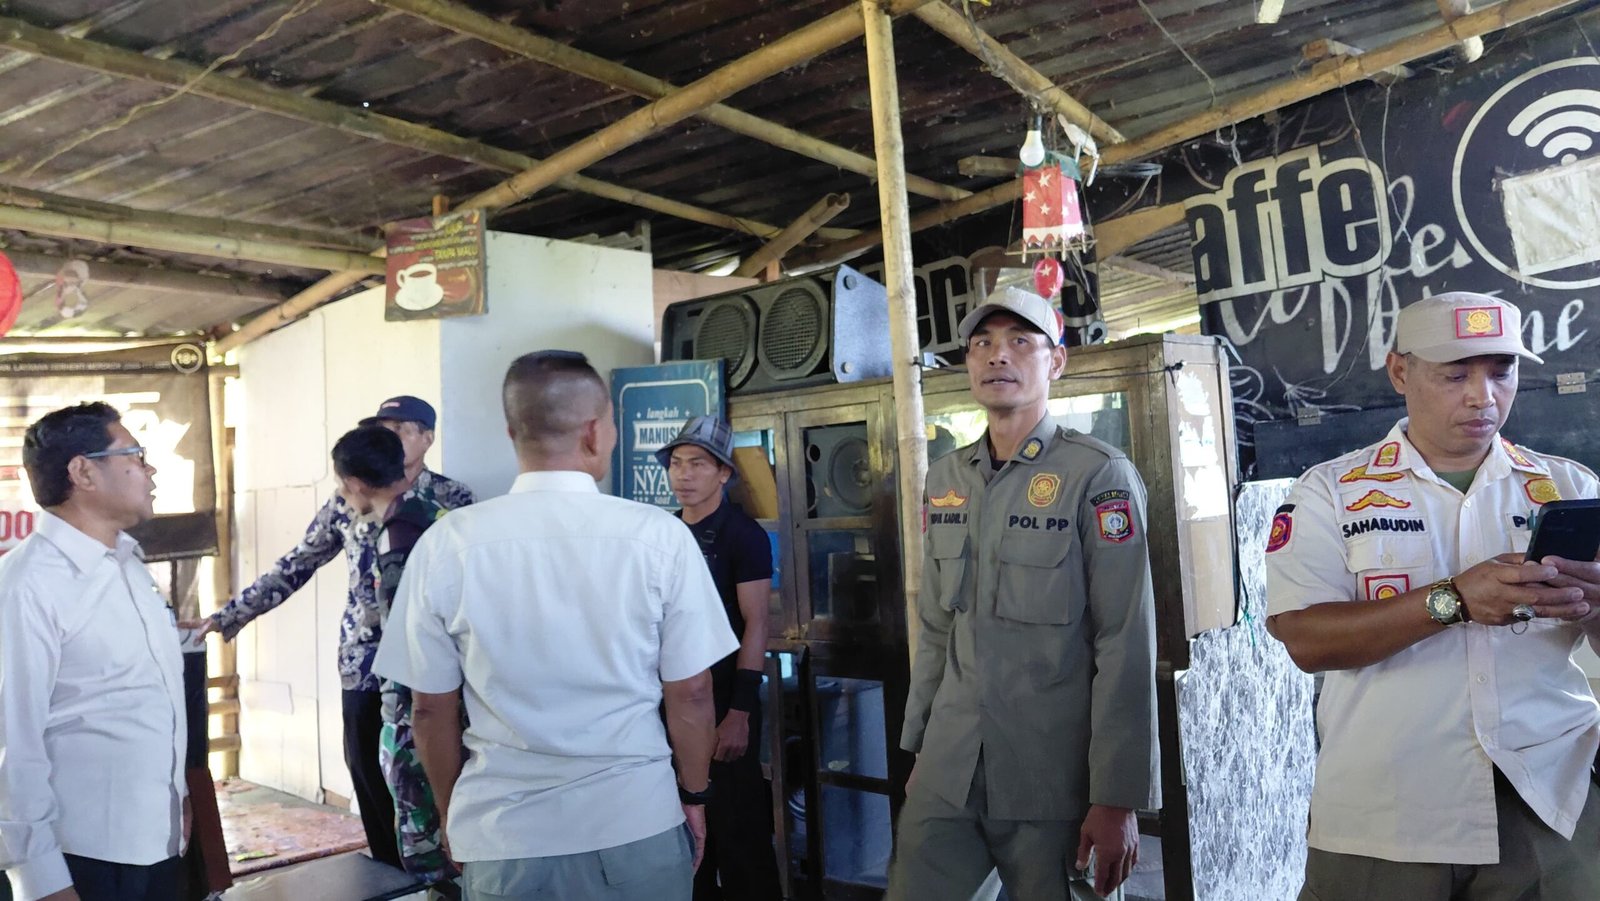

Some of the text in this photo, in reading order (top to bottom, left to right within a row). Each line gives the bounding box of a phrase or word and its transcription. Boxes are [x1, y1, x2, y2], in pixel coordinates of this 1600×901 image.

[646, 406, 679, 420] langkah
[1009, 515, 1069, 531] POL PP
[1342, 517, 1425, 538] SAHABUDIN
